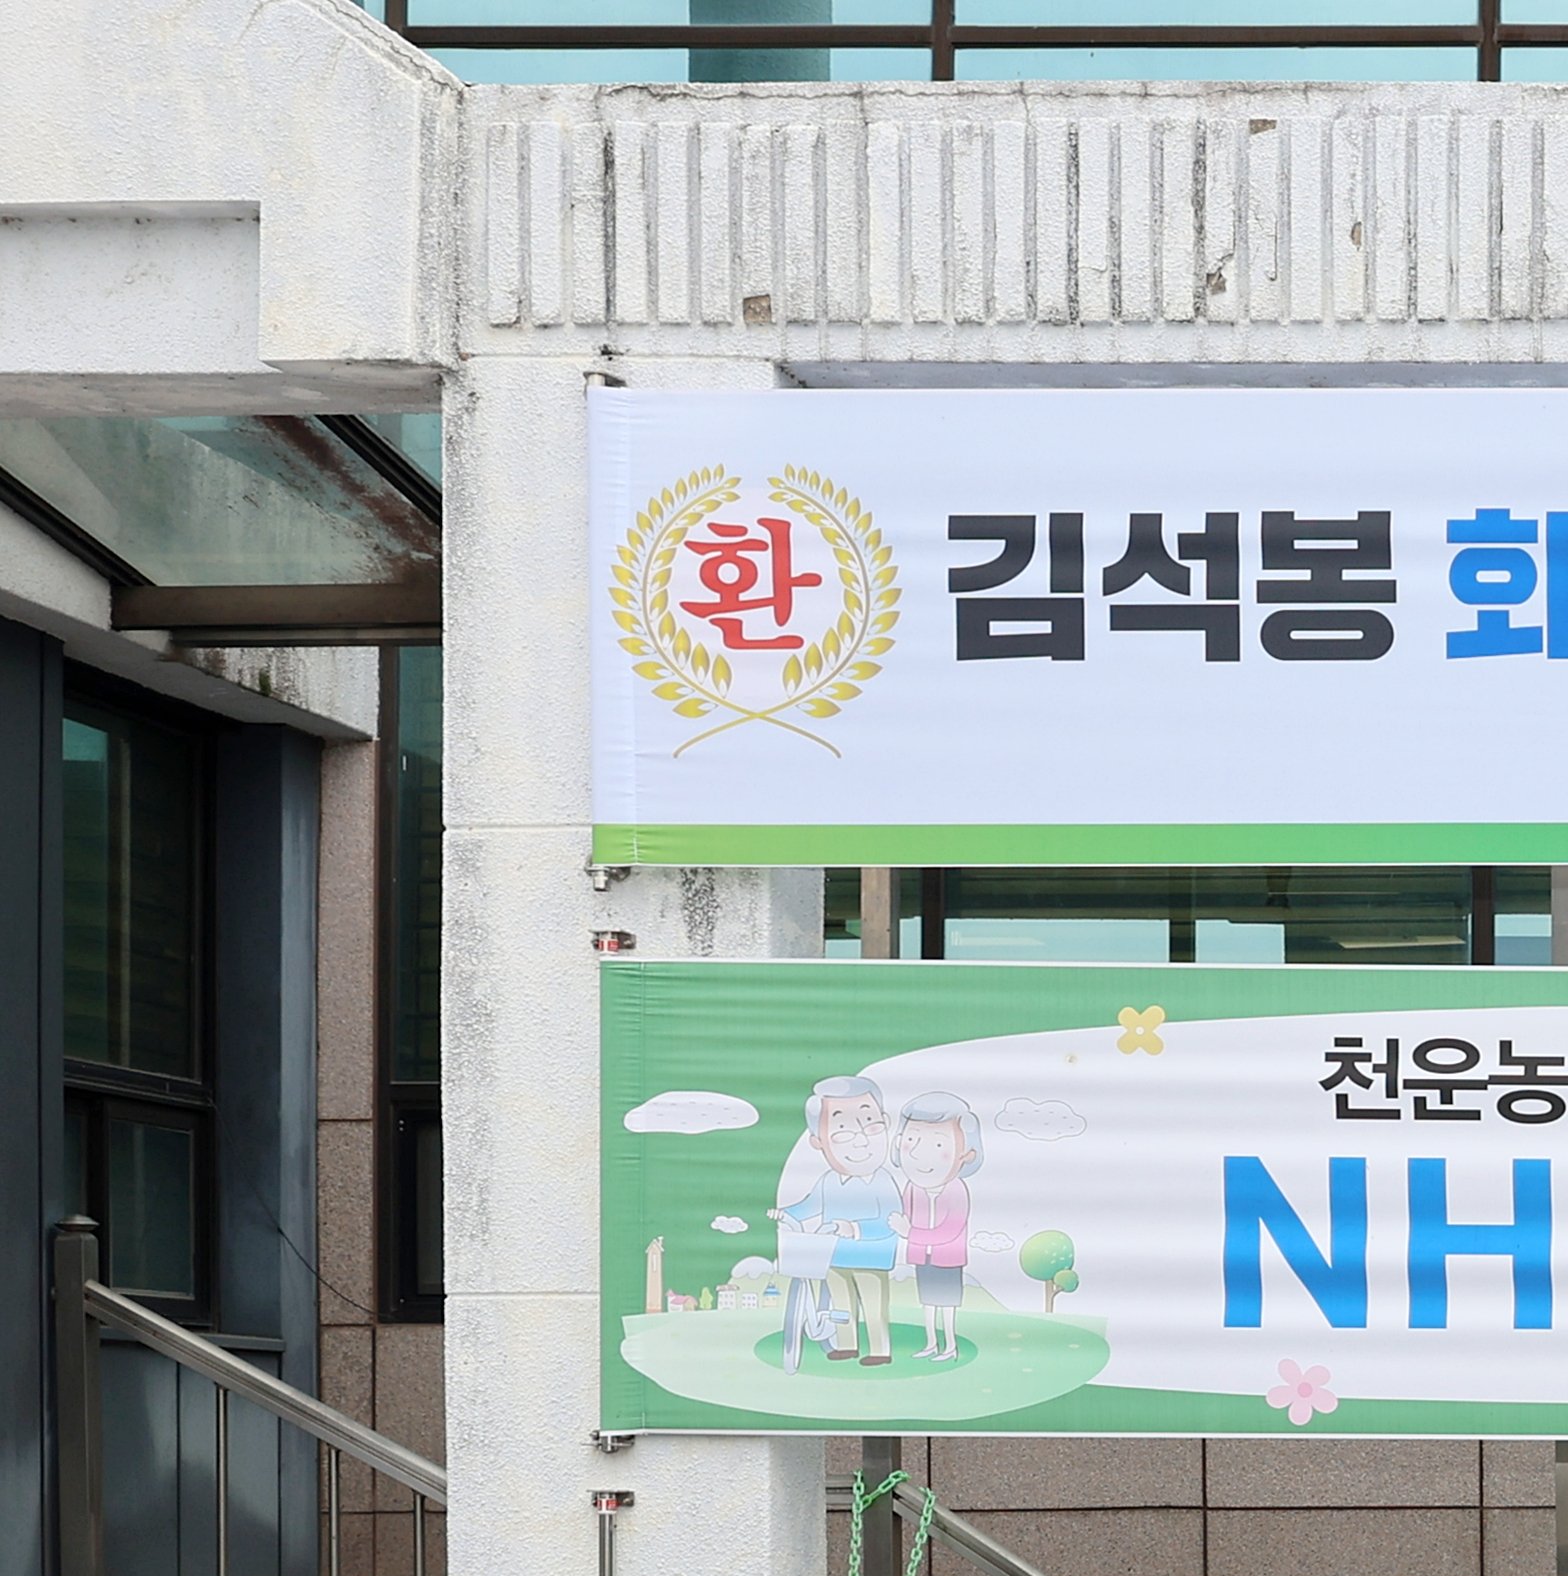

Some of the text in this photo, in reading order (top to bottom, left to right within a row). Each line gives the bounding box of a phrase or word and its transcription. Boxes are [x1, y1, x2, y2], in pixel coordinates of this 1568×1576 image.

[678, 515, 822, 653] 환
[948, 511, 1396, 661] 김석봉
[1224, 1156, 1552, 1329] NH
